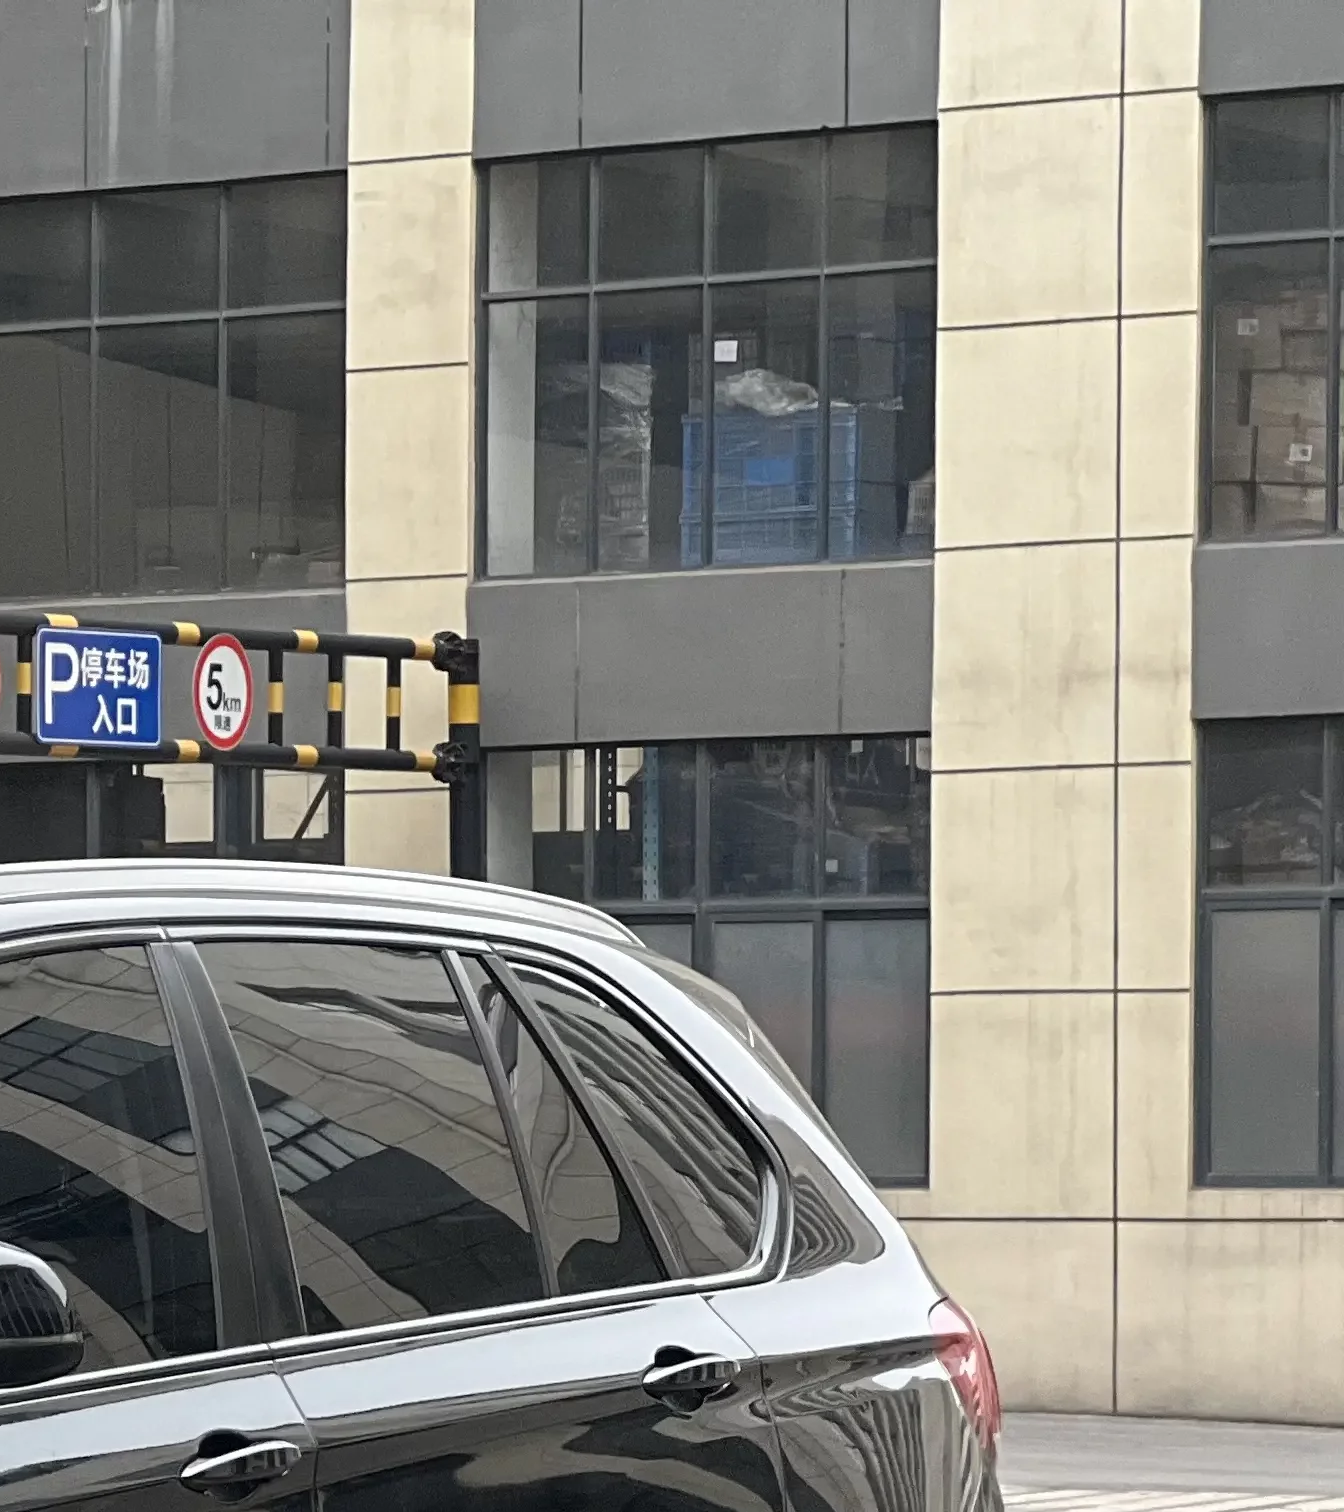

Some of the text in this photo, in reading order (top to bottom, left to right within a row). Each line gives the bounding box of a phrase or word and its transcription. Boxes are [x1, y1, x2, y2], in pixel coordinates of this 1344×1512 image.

[44, 641, 150, 725] P 停车场
[92, 694, 138, 735] 入口
